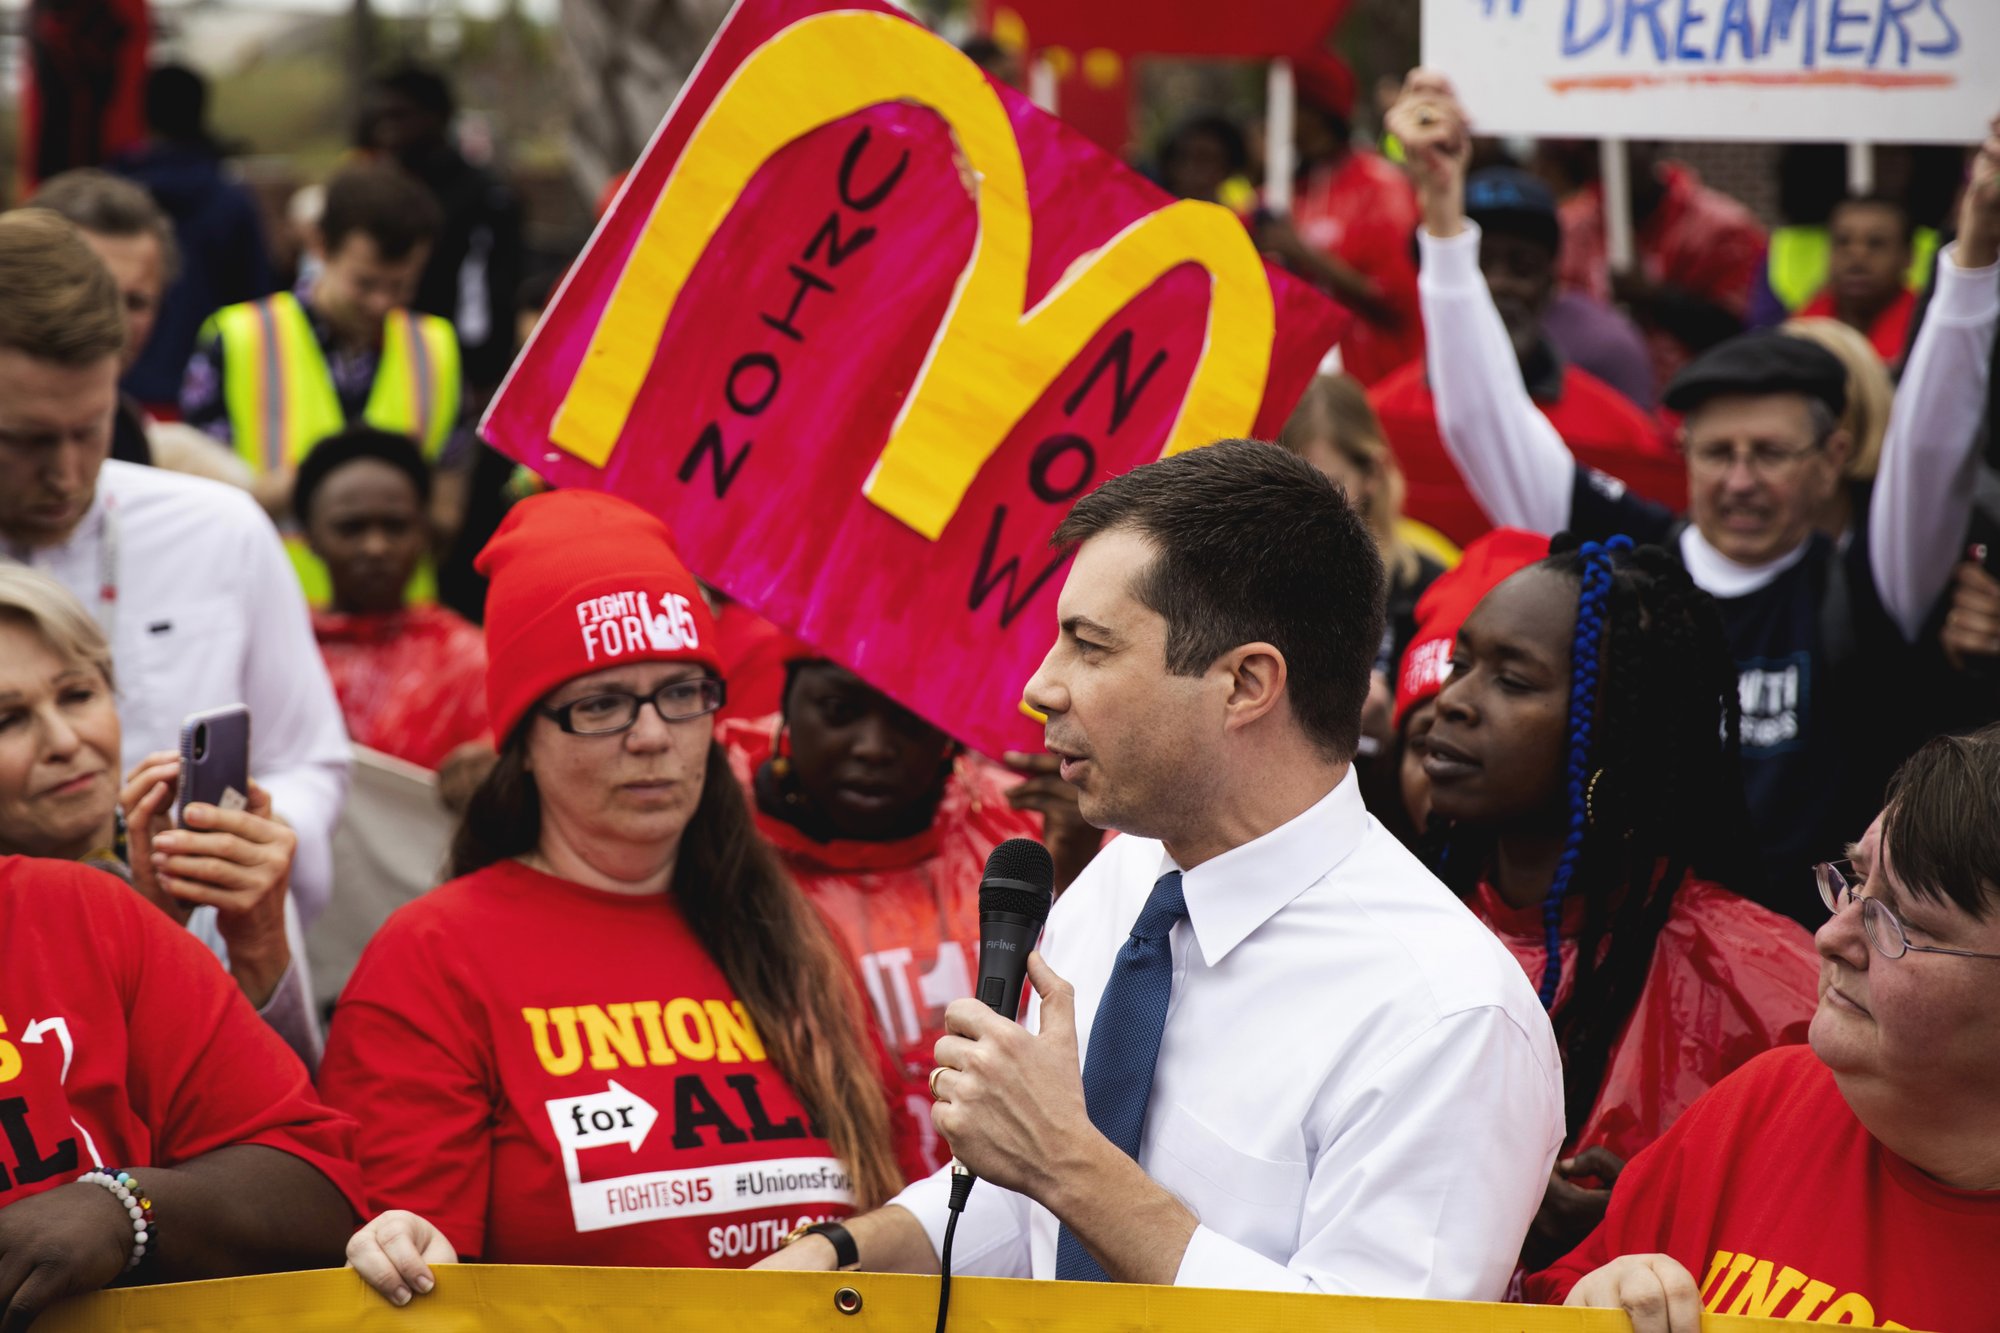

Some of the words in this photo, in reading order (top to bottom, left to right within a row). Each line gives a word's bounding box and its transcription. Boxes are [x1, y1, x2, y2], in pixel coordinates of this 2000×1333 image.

[1560, 0, 1962, 69] DREAMERS
[676, 125, 911, 499] UNION
[967, 327, 1169, 629] NOW
[576, 591, 637, 626] FIGHT
[581, 615, 647, 662] FOR
[571, 1104, 635, 1136] for
[671, 1073, 828, 1150] AL
[708, 1218, 789, 1260] SOUTH
